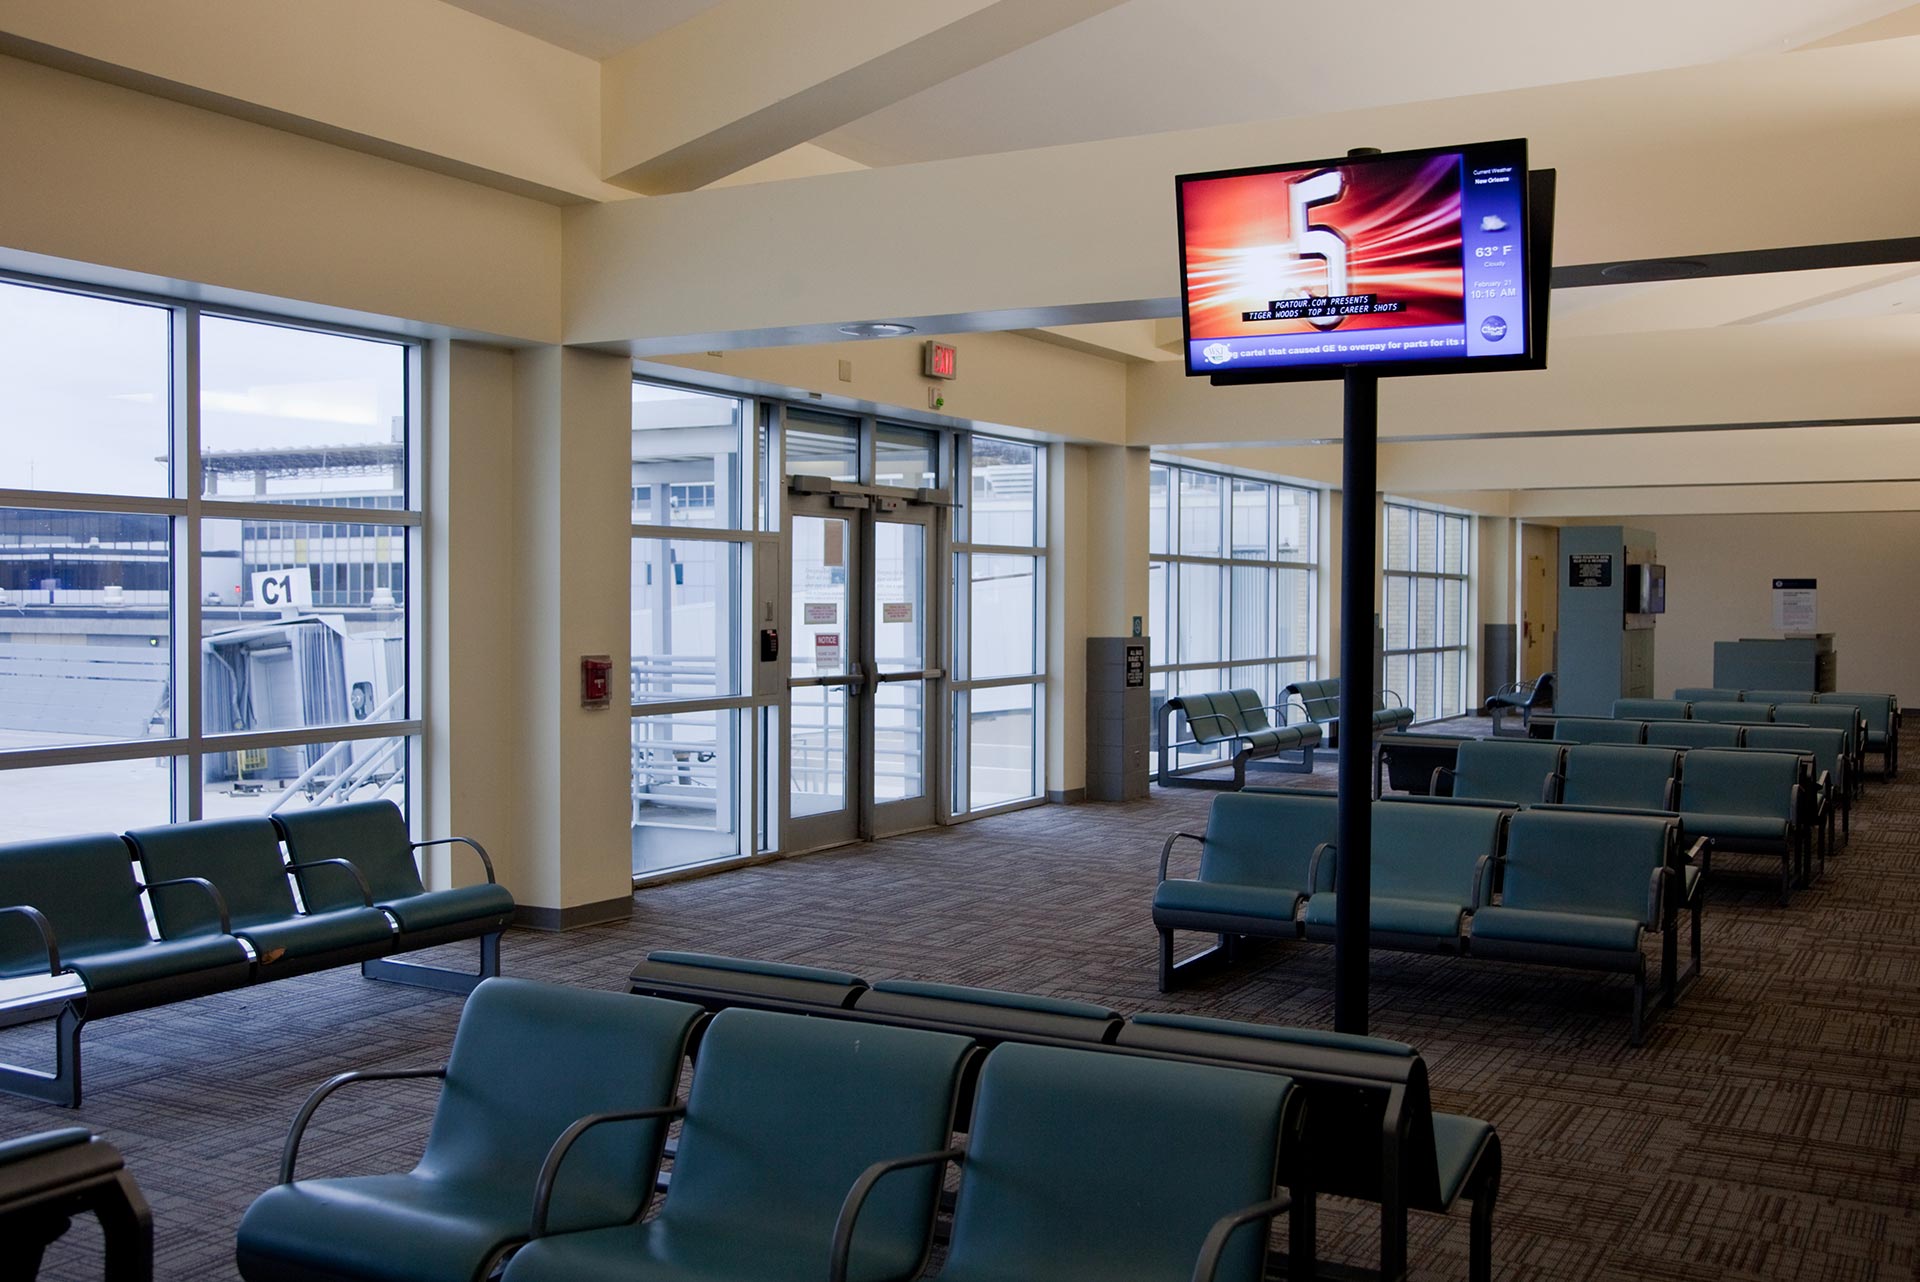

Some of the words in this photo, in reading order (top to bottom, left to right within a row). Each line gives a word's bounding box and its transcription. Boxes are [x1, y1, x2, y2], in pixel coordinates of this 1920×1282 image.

[1287, 170, 1347, 326] 5
[1503, 245, 1512, 255] F
[1474, 280, 1501, 289] February
[1500, 288, 1516, 296] AM
[1275, 298, 1327, 309] PGATOUR.COM
[1330, 295, 1369, 305] PRESENTS
[1250, 312, 1272, 320] TIGER
[1275, 309, 1303, 318] WOODS'
[1308, 308, 1322, 316] TOP
[1327, 307, 1336, 315] 10
[1340, 305, 1369, 314] CAREER
[1373, 303, 1398, 312] SHOTS
[1240, 348, 1266, 357] cartel
[1268, 347, 1287, 355] that
[1288, 345, 1320, 354] caused
[1322, 344, 1336, 352] GE
[1338, 344, 1348, 352] to
[1349, 343, 1386, 352] overpay
[1388, 341, 1401, 349] for
[1403, 339, 1428, 350] parts
[1430, 338, 1444, 347] for
[1446, 338, 1459, 346] its
[934, 346, 954, 376] EXIT
[262, 575, 292, 605] C1
[817, 636, 837, 645] NOTICE
